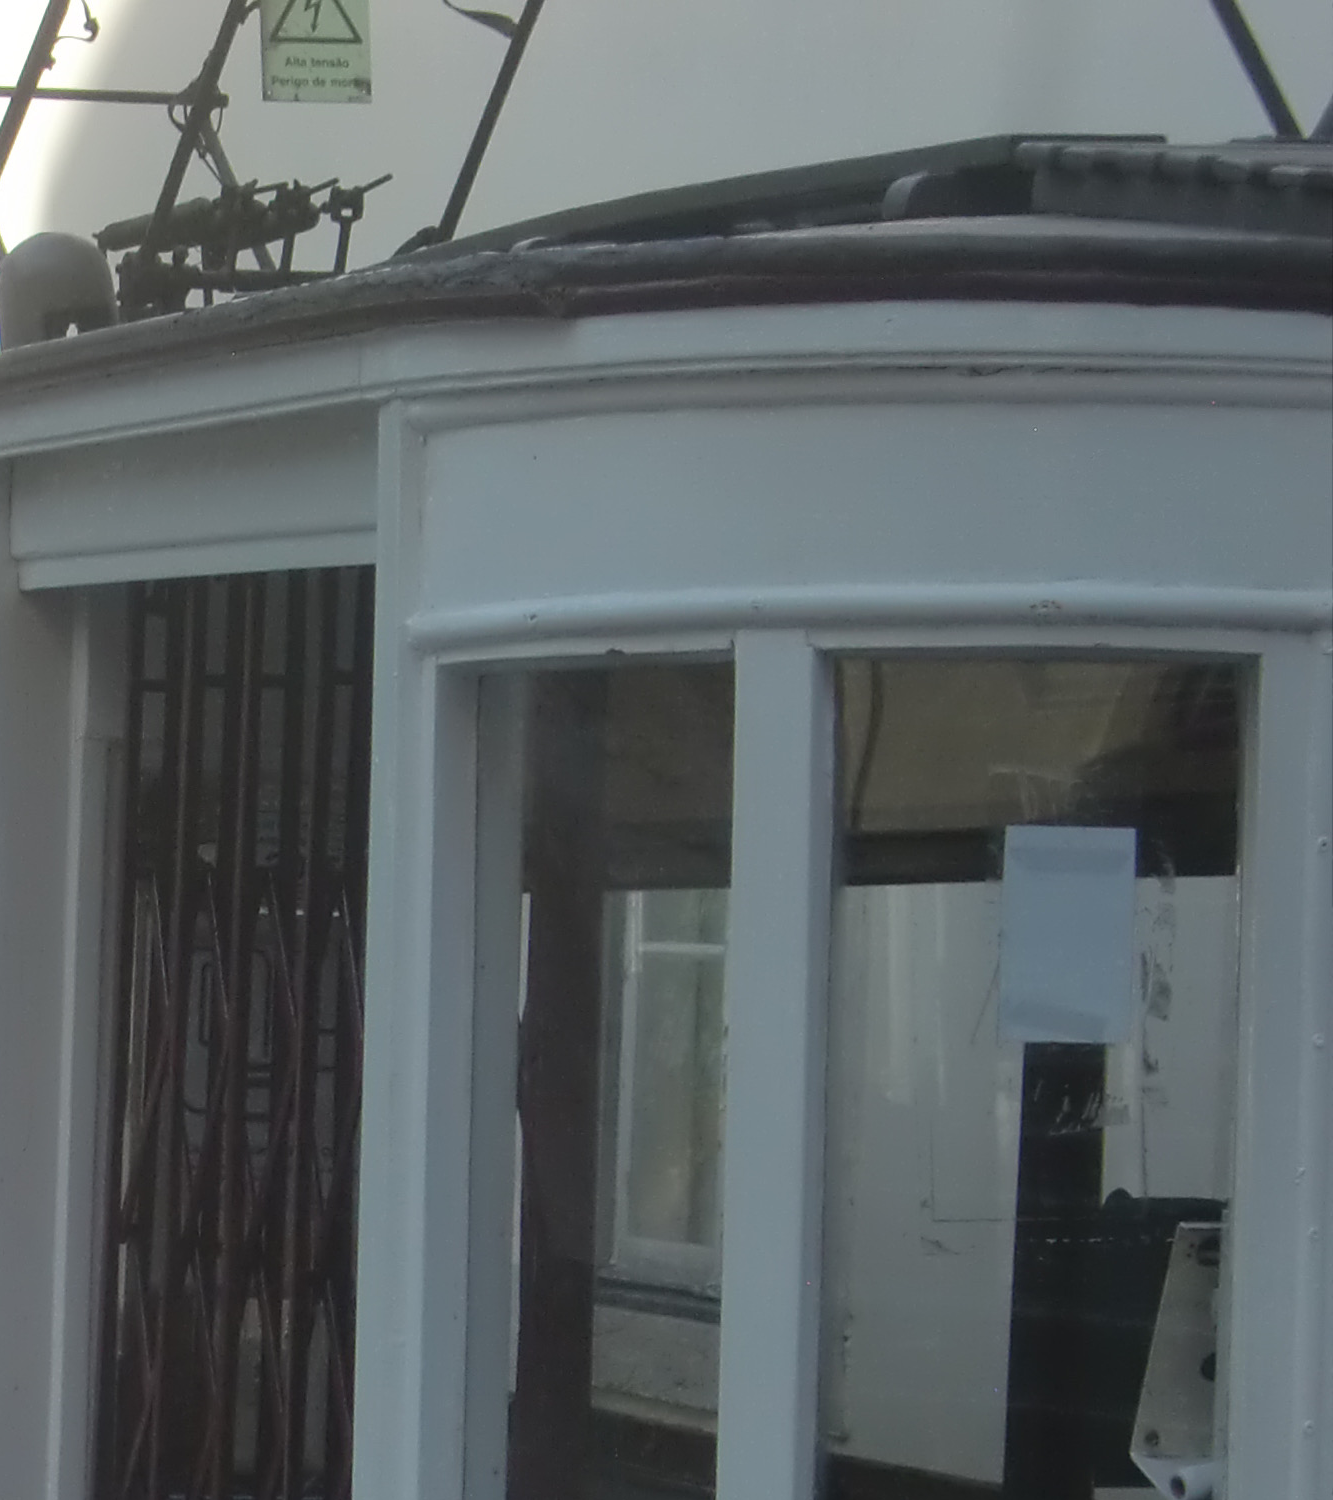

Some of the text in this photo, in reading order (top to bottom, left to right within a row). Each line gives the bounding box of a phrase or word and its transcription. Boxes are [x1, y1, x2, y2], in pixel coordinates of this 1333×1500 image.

[284, 55, 350, 68] Alta tensão
[271, 74, 309, 88] Perigo
[312, 75, 326, 87] de
